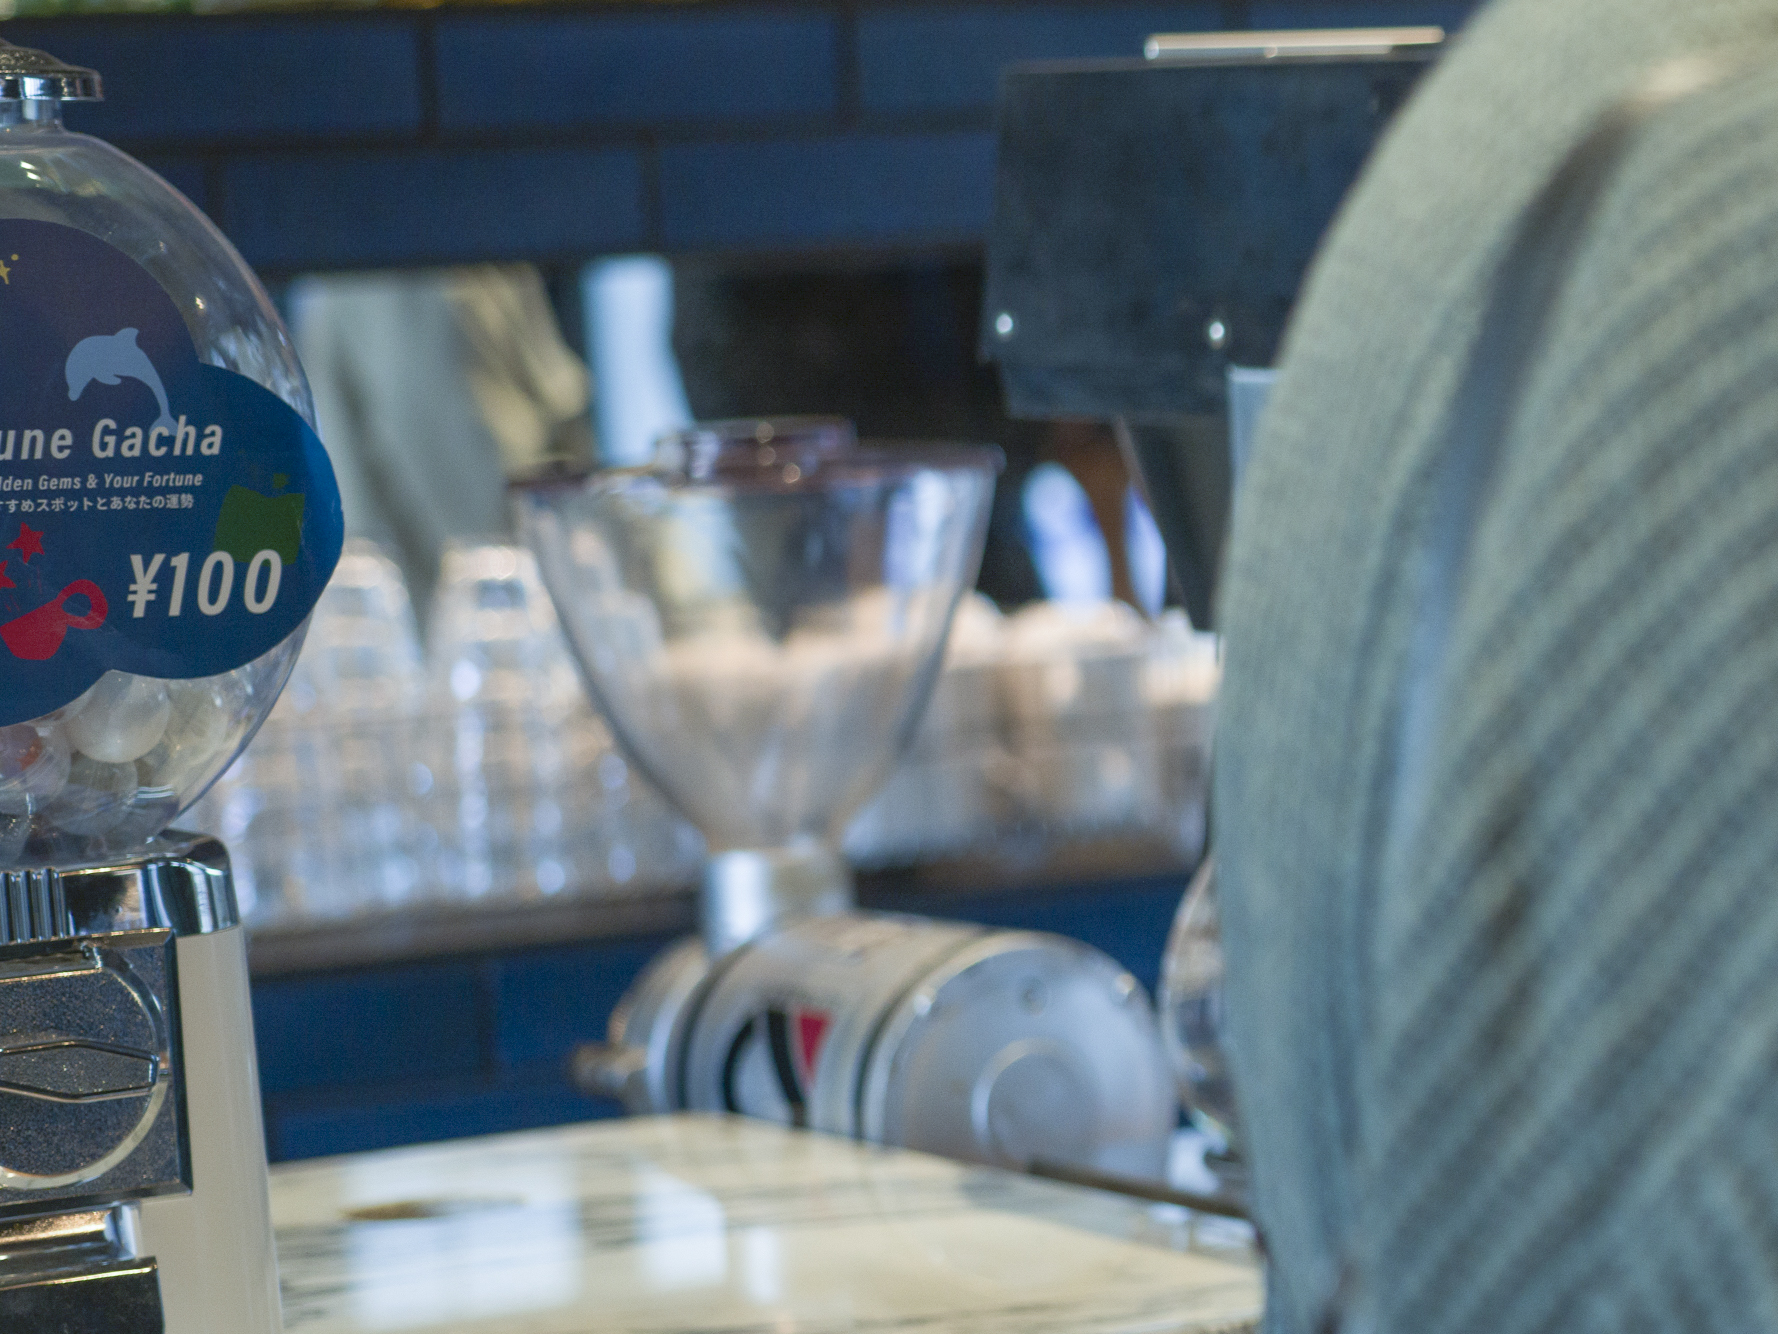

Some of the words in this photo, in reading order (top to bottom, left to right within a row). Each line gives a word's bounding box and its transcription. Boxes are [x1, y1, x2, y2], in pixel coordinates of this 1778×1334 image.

[91, 414, 223, 459] Gacha
[0, 474, 33, 492] den
[38, 474, 81, 491] Gems
[86, 473, 98, 489] &
[104, 472, 140, 488] Your
[143, 471, 203, 488] Fortune
[0, 493, 194, 514] すめスポットとあなたの運勢
[126, 548, 283, 618] ¥100
